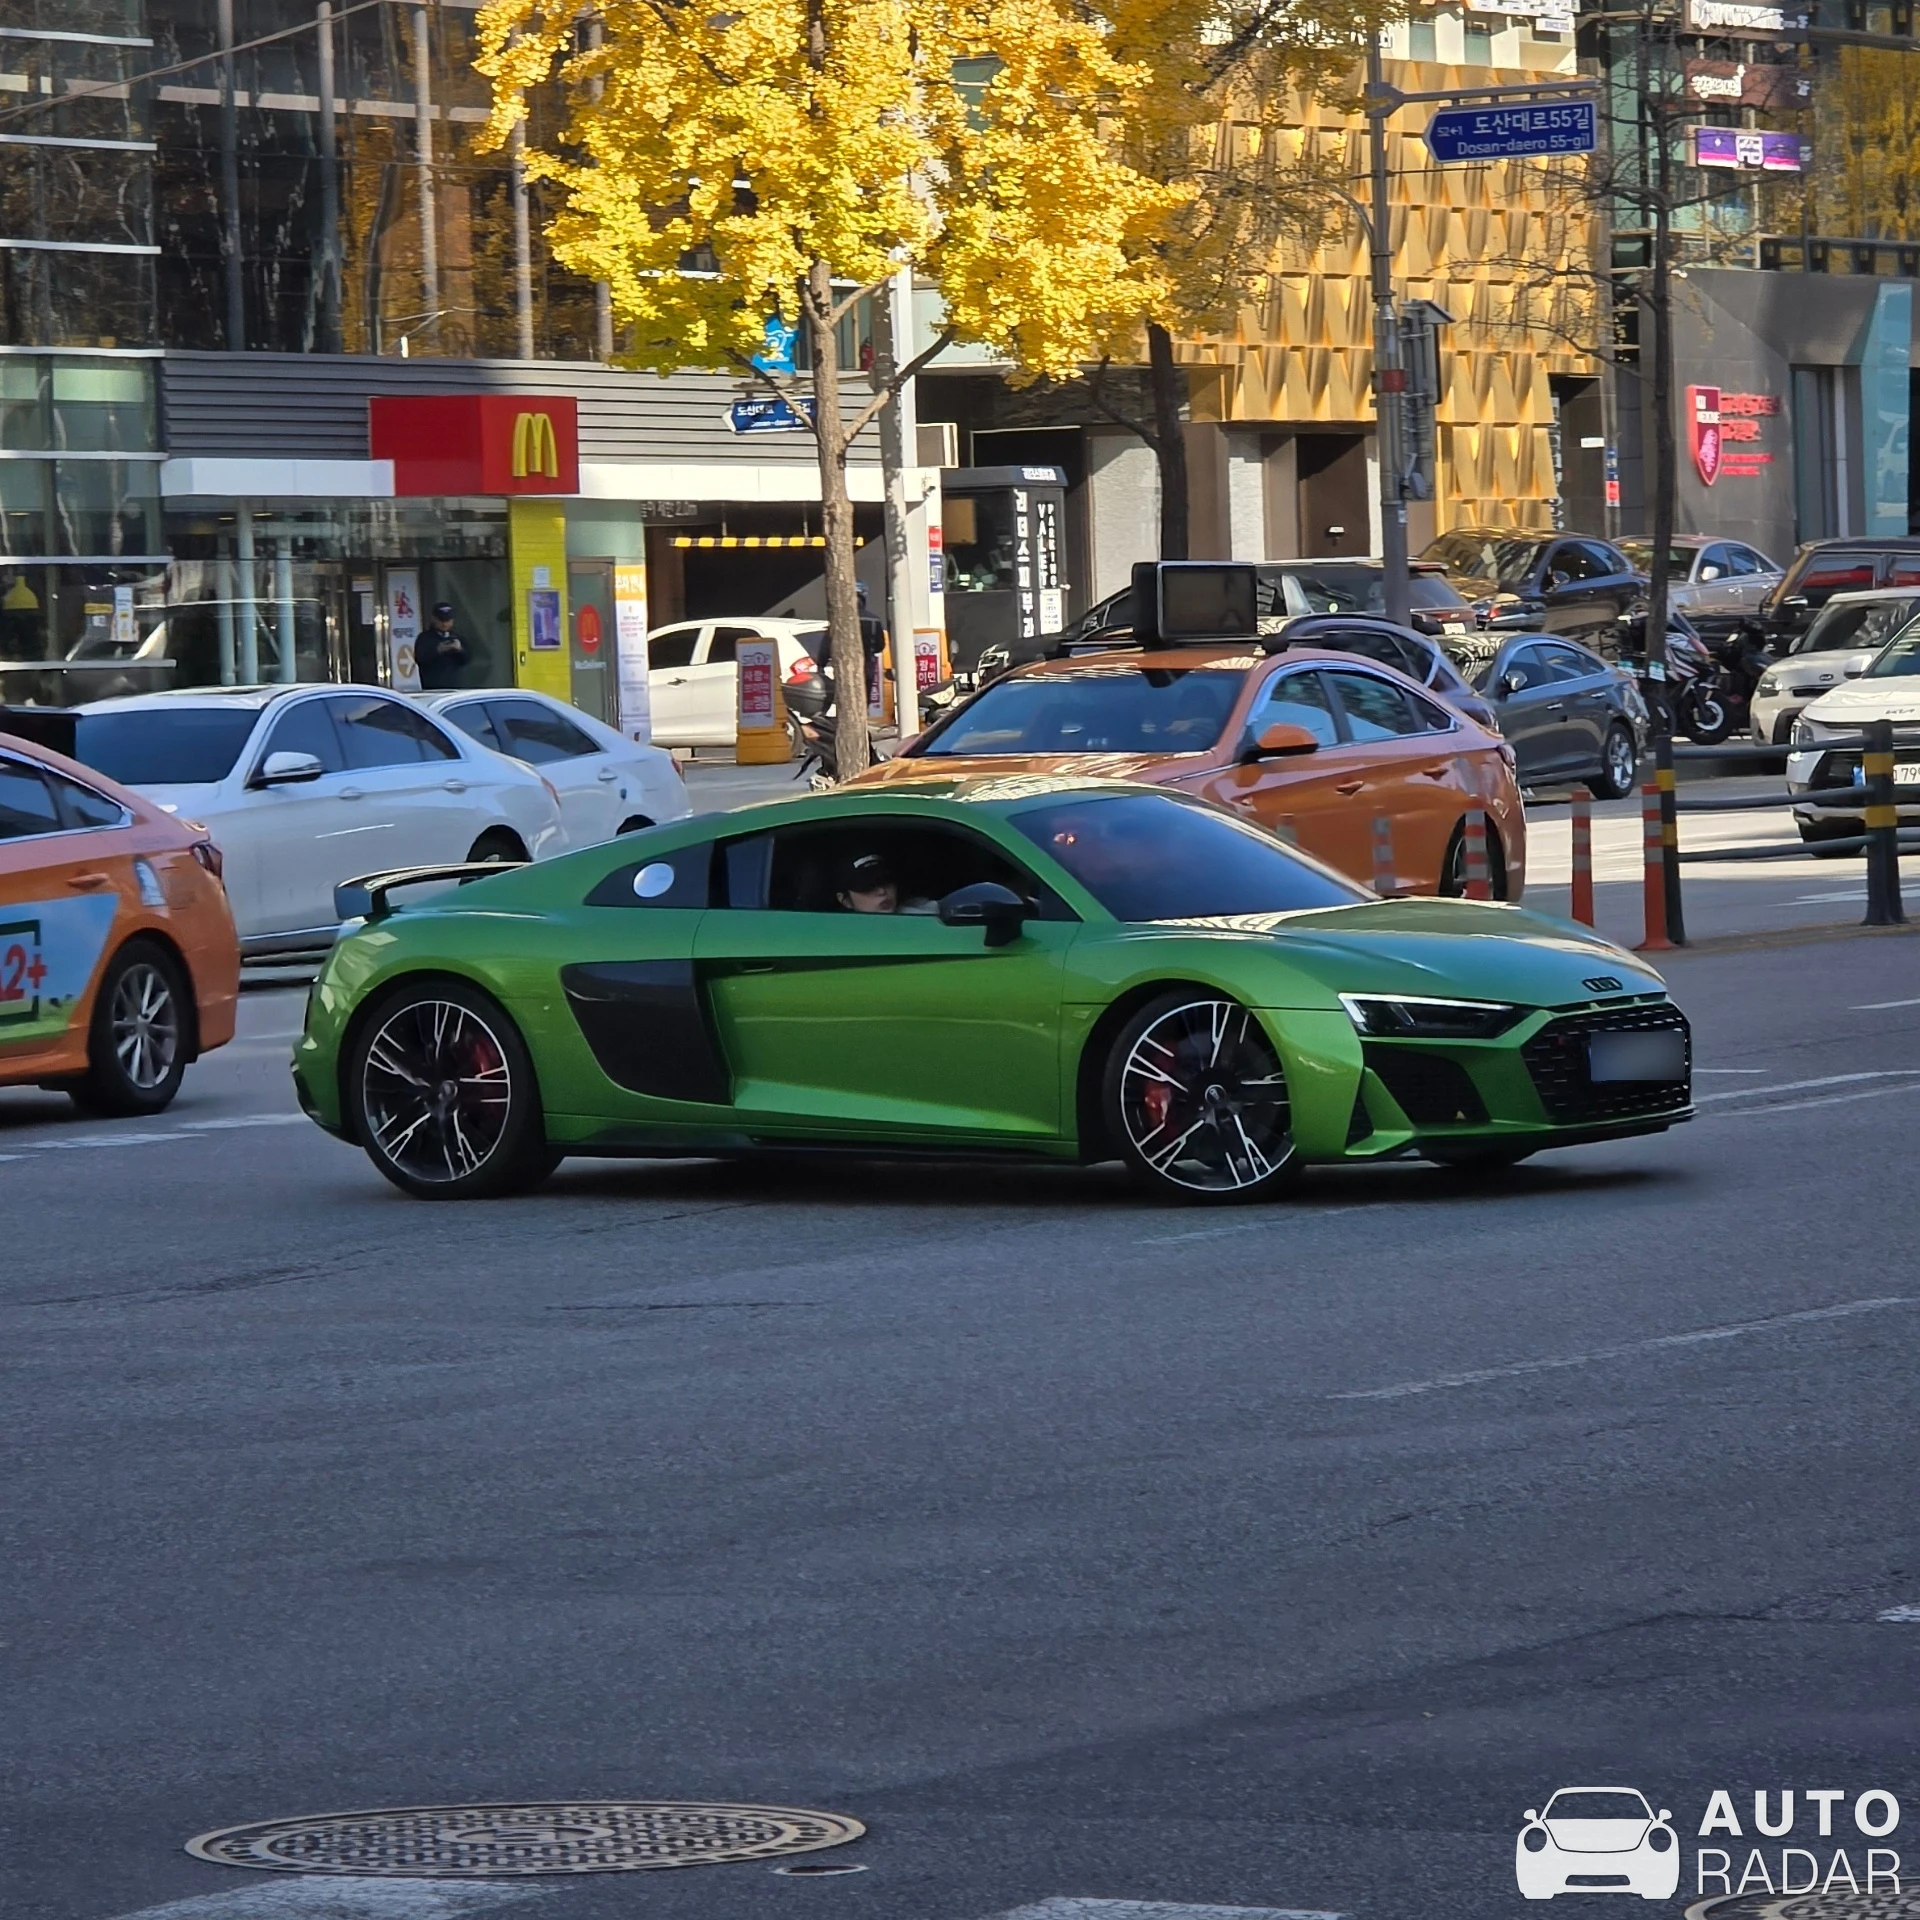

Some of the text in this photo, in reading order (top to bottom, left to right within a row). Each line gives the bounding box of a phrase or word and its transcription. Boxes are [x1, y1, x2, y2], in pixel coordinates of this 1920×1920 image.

[1473, 106, 1590, 135] 도산대로55길
[1457, 133, 1590, 155] Dosan-daero 55-gil
[1037, 503, 1048, 587] VALET
